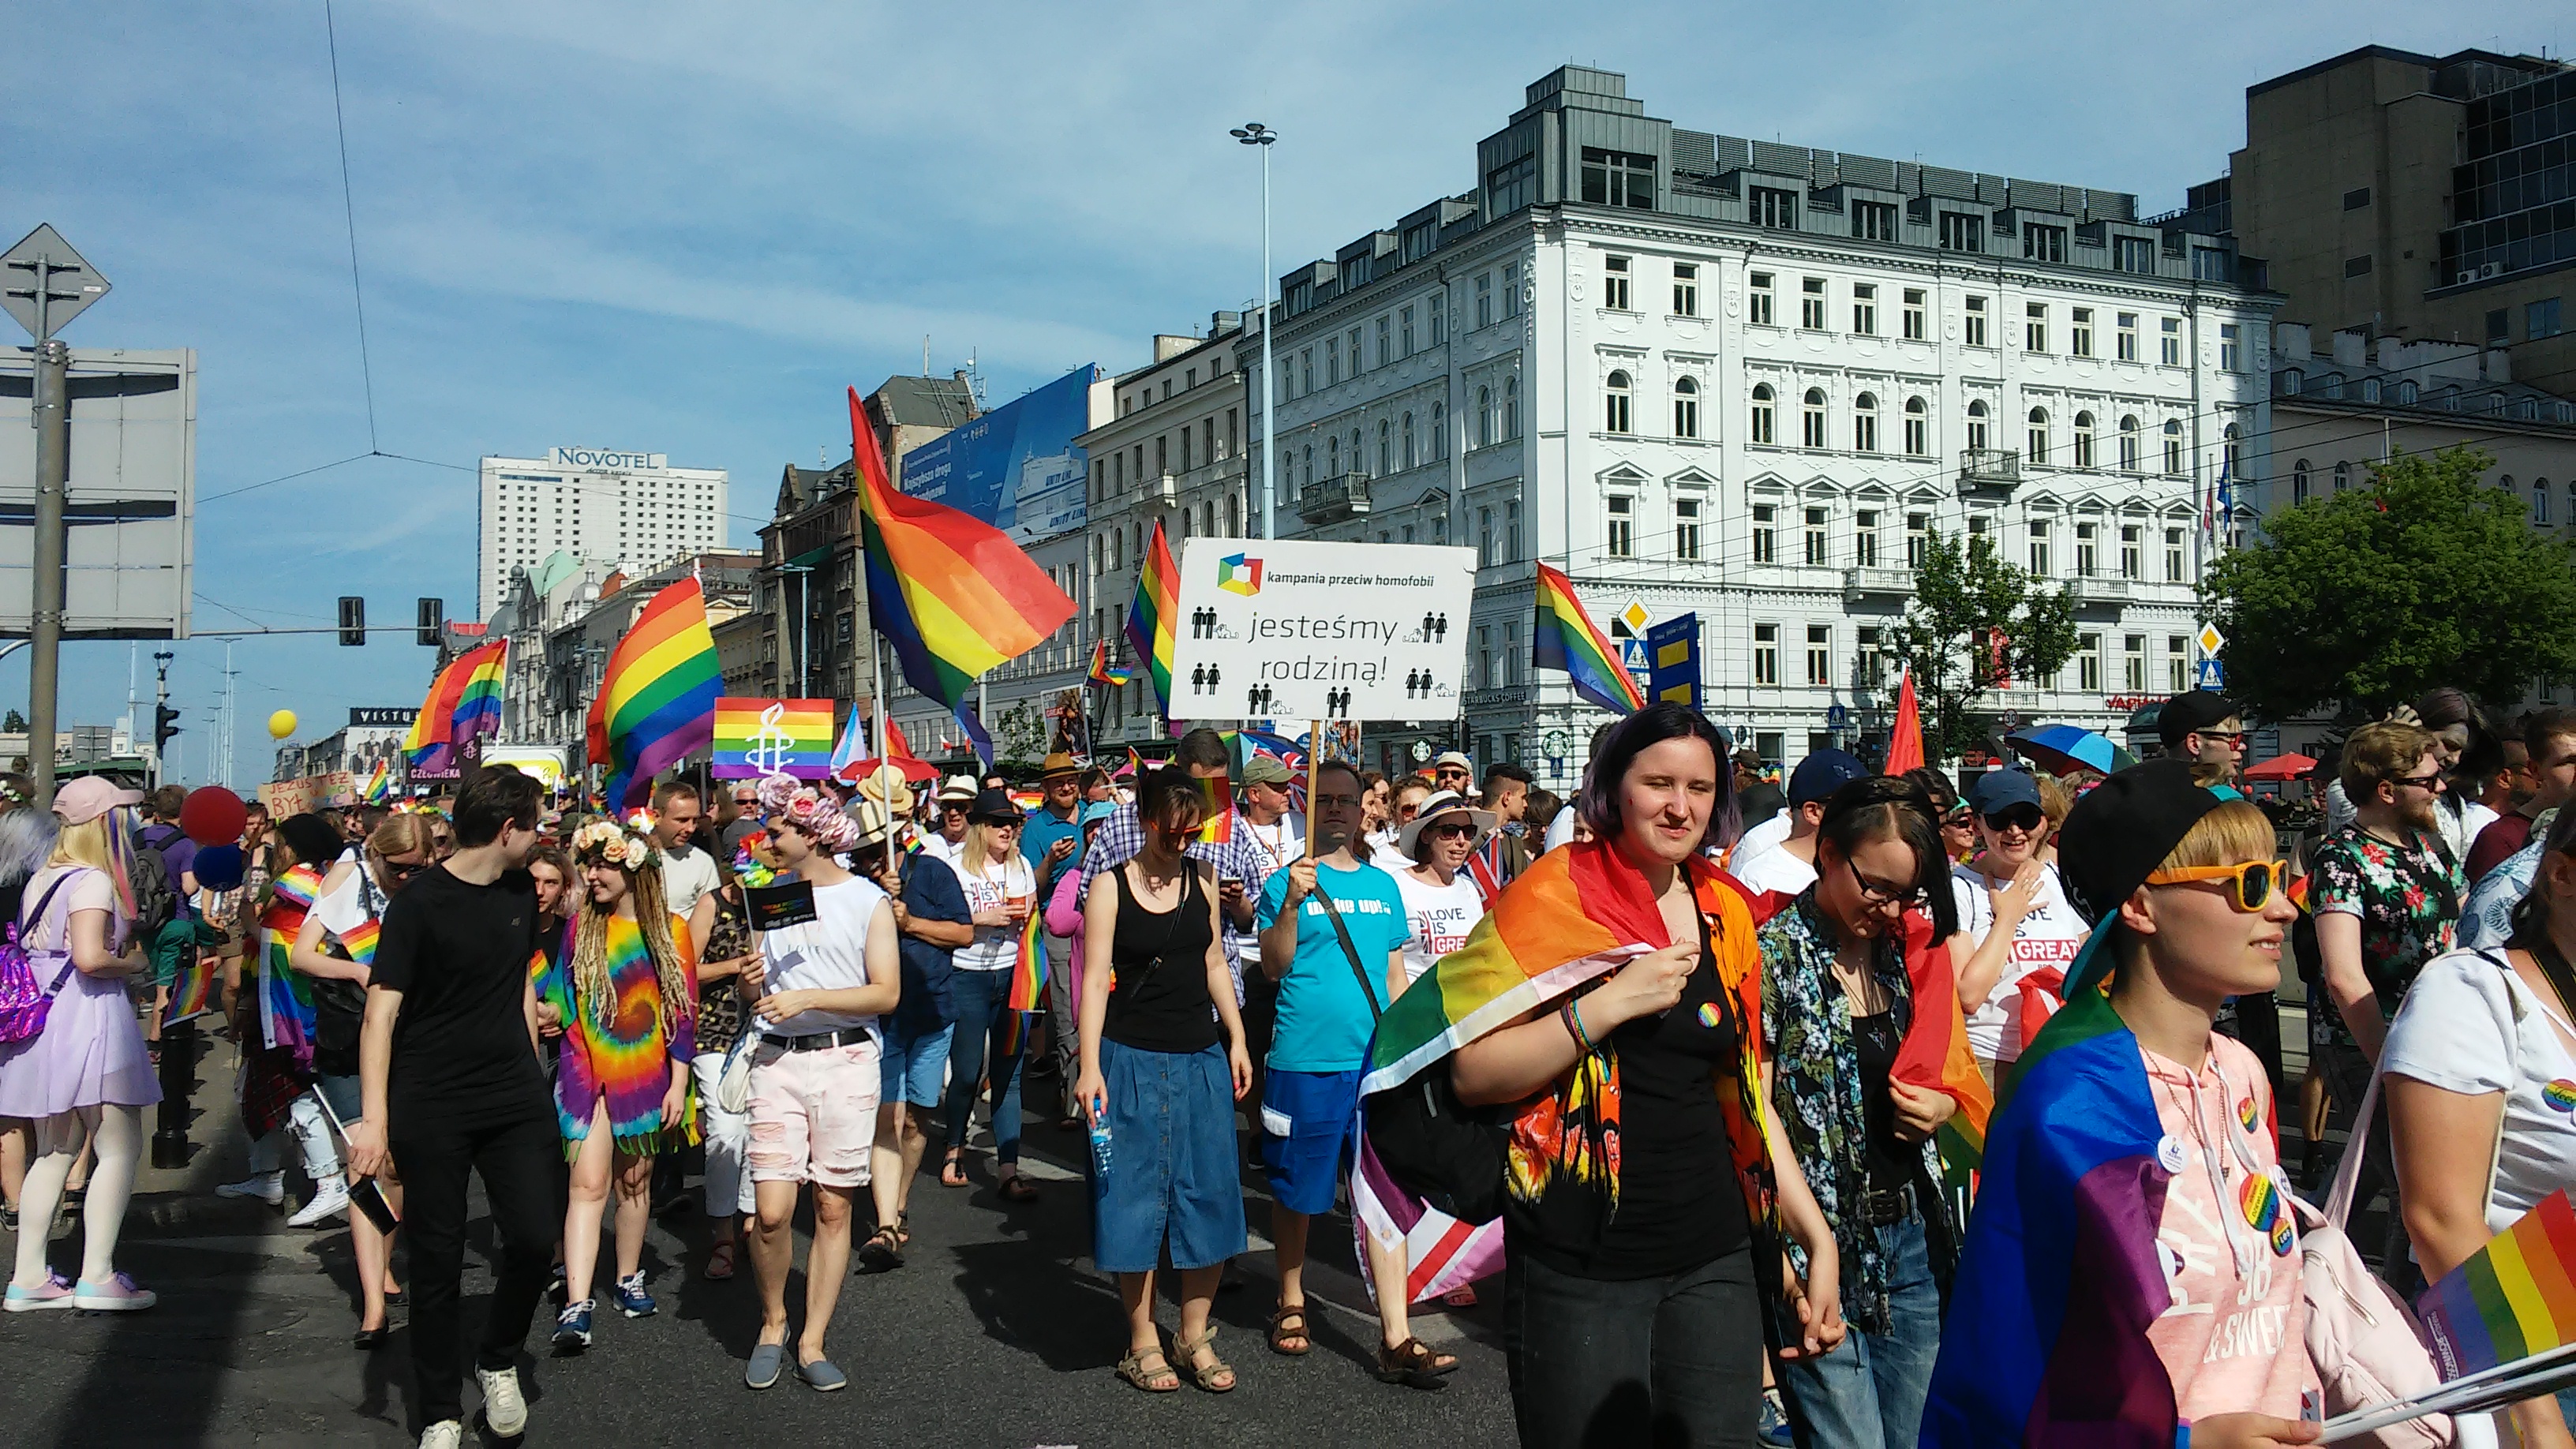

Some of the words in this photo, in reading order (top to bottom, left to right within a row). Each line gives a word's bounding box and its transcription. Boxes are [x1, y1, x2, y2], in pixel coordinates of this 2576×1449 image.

[558, 447, 659, 469] NOVOTEL
[1267, 571, 1325, 586] kampania
[1328, 574, 1372, 586] przeciw
[1376, 574, 1435, 587] homofobii
[1247, 612, 1398, 646] jesteśmy
[1260, 654, 1387, 687] rodziną!
[1464, 694, 1500, 705] STARBUCKS
[1501, 691, 1526, 702] COFFEE
[360, 710, 412, 721] VISTU
[2005, 713, 2016, 723] 30
[268, 778, 312, 795] JEZUS
[981, 891, 993, 900] IS
[1428, 908, 1466, 921] LOVE
[1433, 922, 1446, 934] IS
[1436, 938, 1466, 953] GRE
